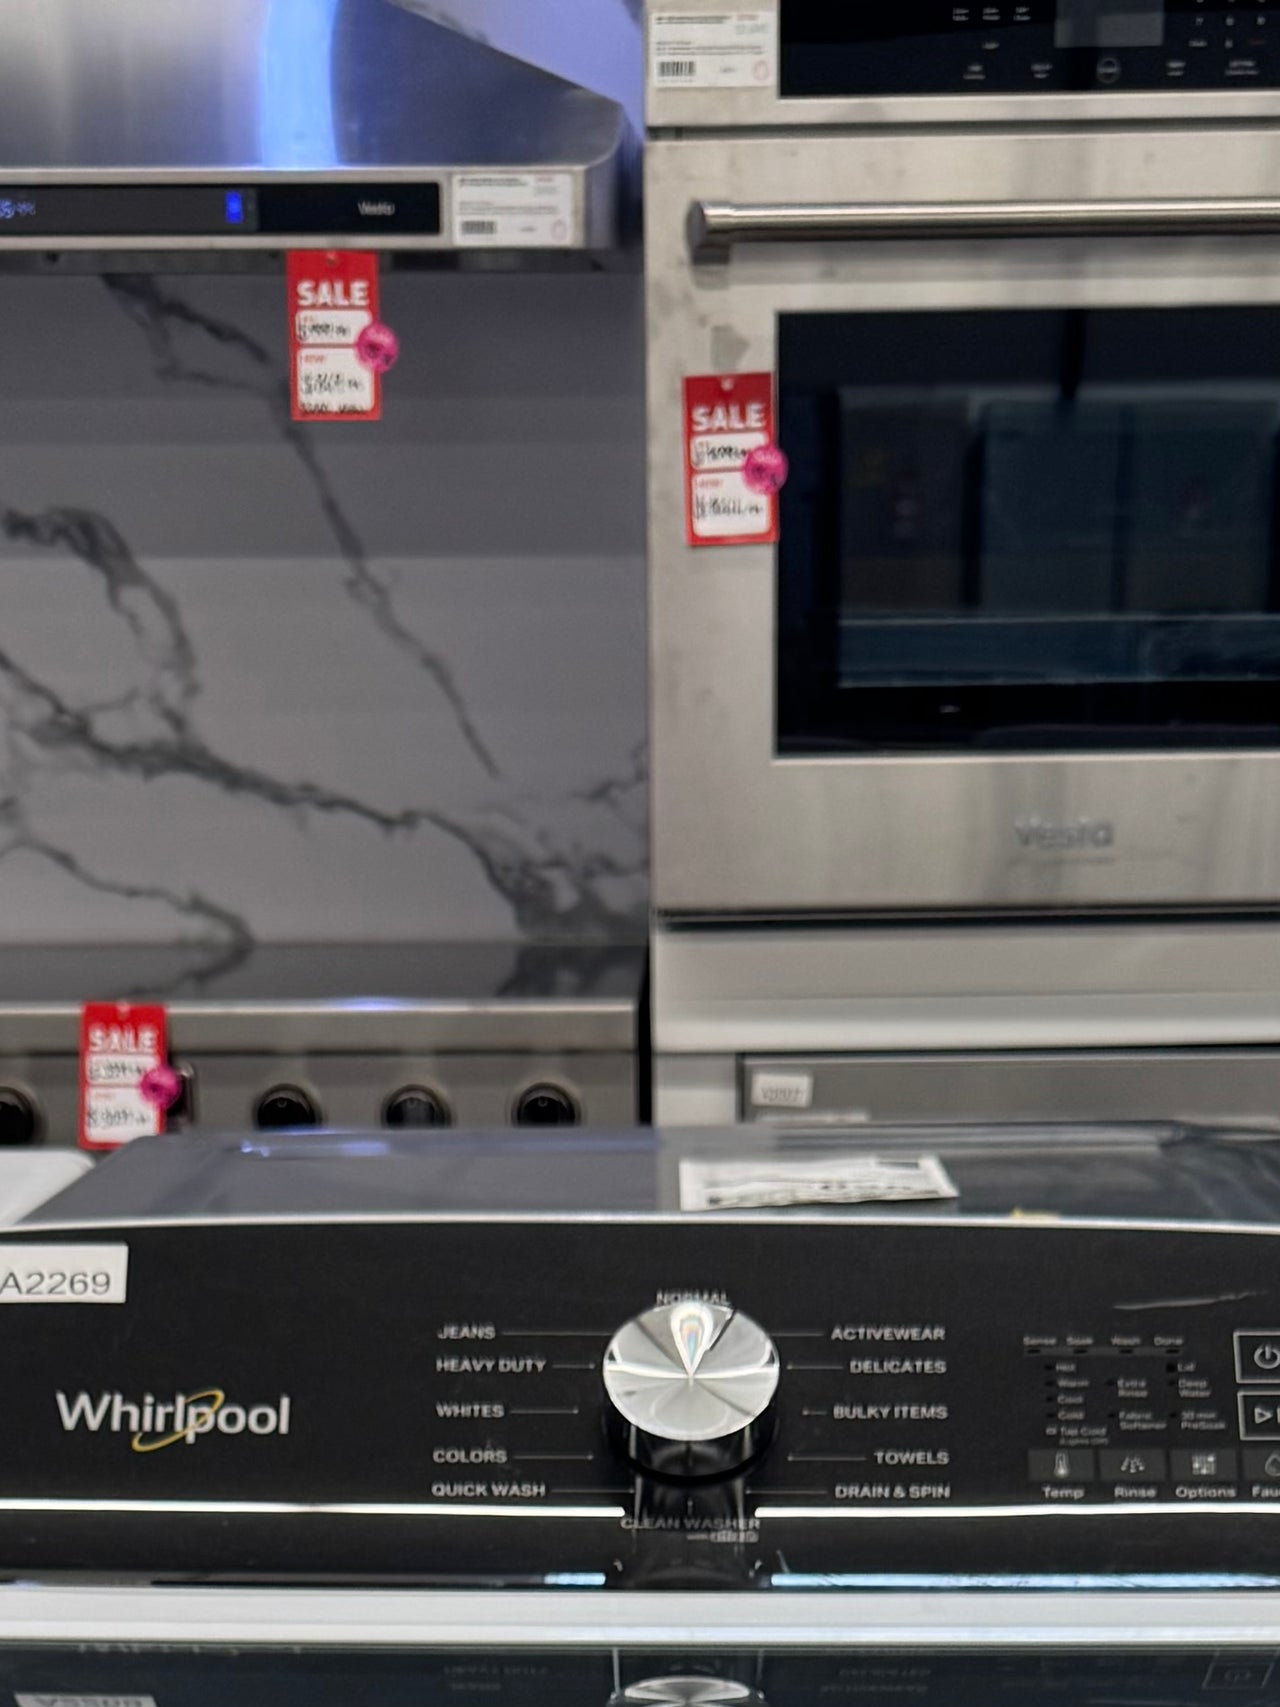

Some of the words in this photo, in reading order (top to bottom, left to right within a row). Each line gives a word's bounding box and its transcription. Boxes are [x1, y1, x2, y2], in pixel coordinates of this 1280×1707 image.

[296, 279, 369, 307] SALE
[691, 401, 765, 433] SALE
[88, 1023, 159, 1053] SALE
[437, 1325, 496, 1340] JEANS
[831, 1326, 946, 1341] ACTIVEWEAR
[436, 1358, 494, 1373] HEAVY
[499, 1358, 547, 1373] DUTY
[849, 1359, 947, 1374] DELICATES
[436, 1403, 505, 1418] WHITES
[833, 1404, 891, 1419] BULKY
[894, 1404, 948, 1419] ITEMS
[55, 1388, 291, 1449] Whirlpool
[433, 1449, 508, 1465] COLORS
[873, 1450, 950, 1465] TOWELS
[432, 1482, 489, 1498] QUICK
[492, 1482, 546, 1498] WASH
[834, 1484, 890, 1499] DRAIN
[893, 1485, 905, 1499] &
[909, 1484, 951, 1499] SPIN
[1042, 1486, 1085, 1500] Temp
[1114, 1485, 1157, 1498] Rinse
[1175, 1485, 1236, 1500] Options
[620, 1517, 680, 1530] CLEAN
[684, 1517, 761, 1530] WASHER
